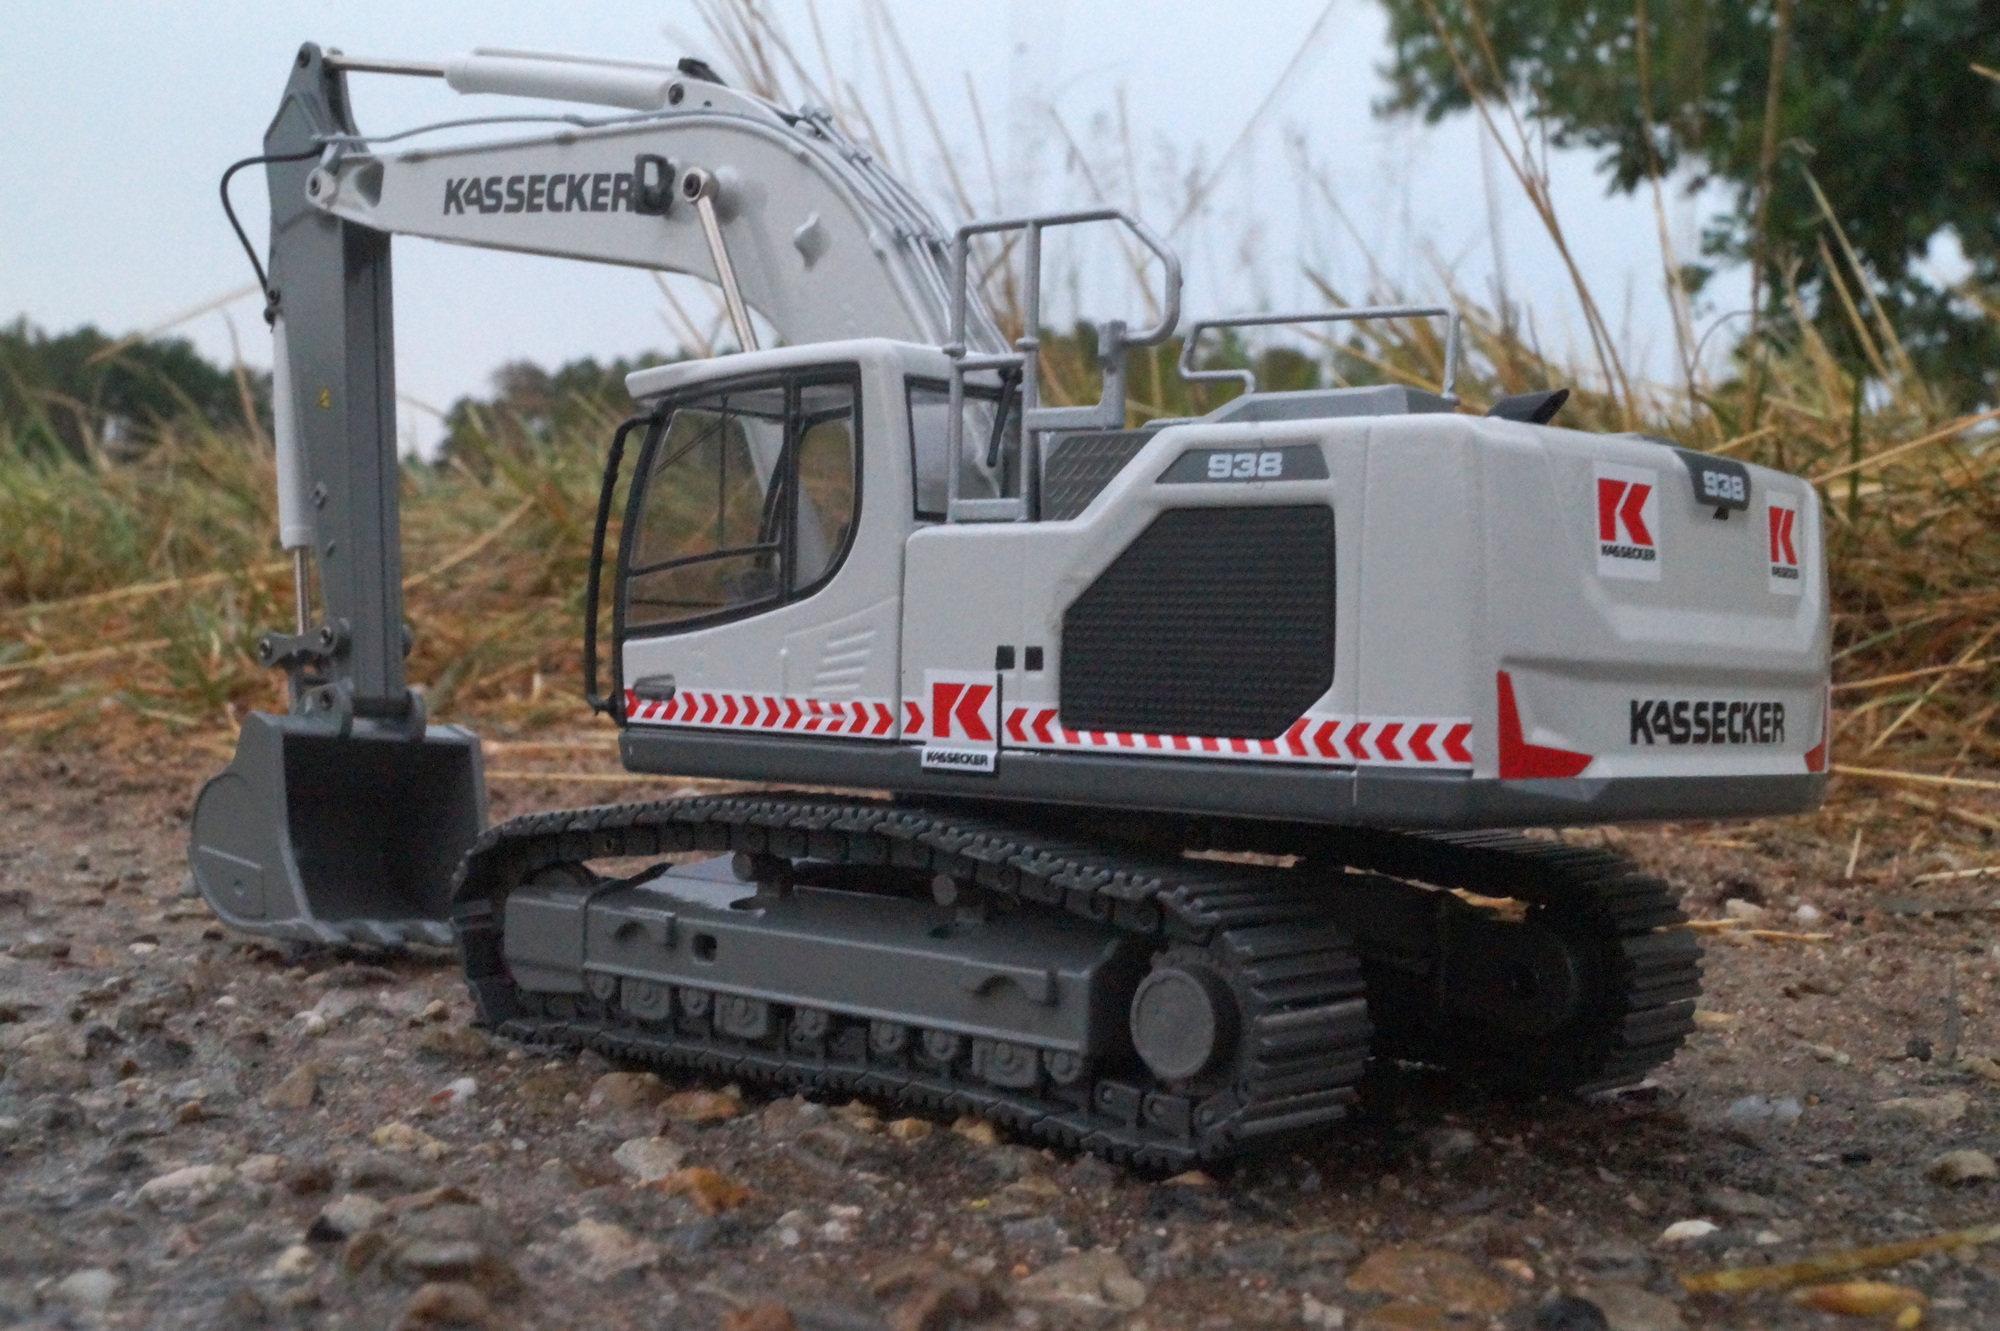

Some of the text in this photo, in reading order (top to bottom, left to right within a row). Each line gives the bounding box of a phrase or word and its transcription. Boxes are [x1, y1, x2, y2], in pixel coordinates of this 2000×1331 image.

[443, 172, 635, 216] KASSECKER
[1207, 452, 1283, 478] 938
[1703, 470, 1744, 501] 938
[1630, 699, 1785, 745] KASSECKER
[926, 751, 988, 766] KASSECKER
